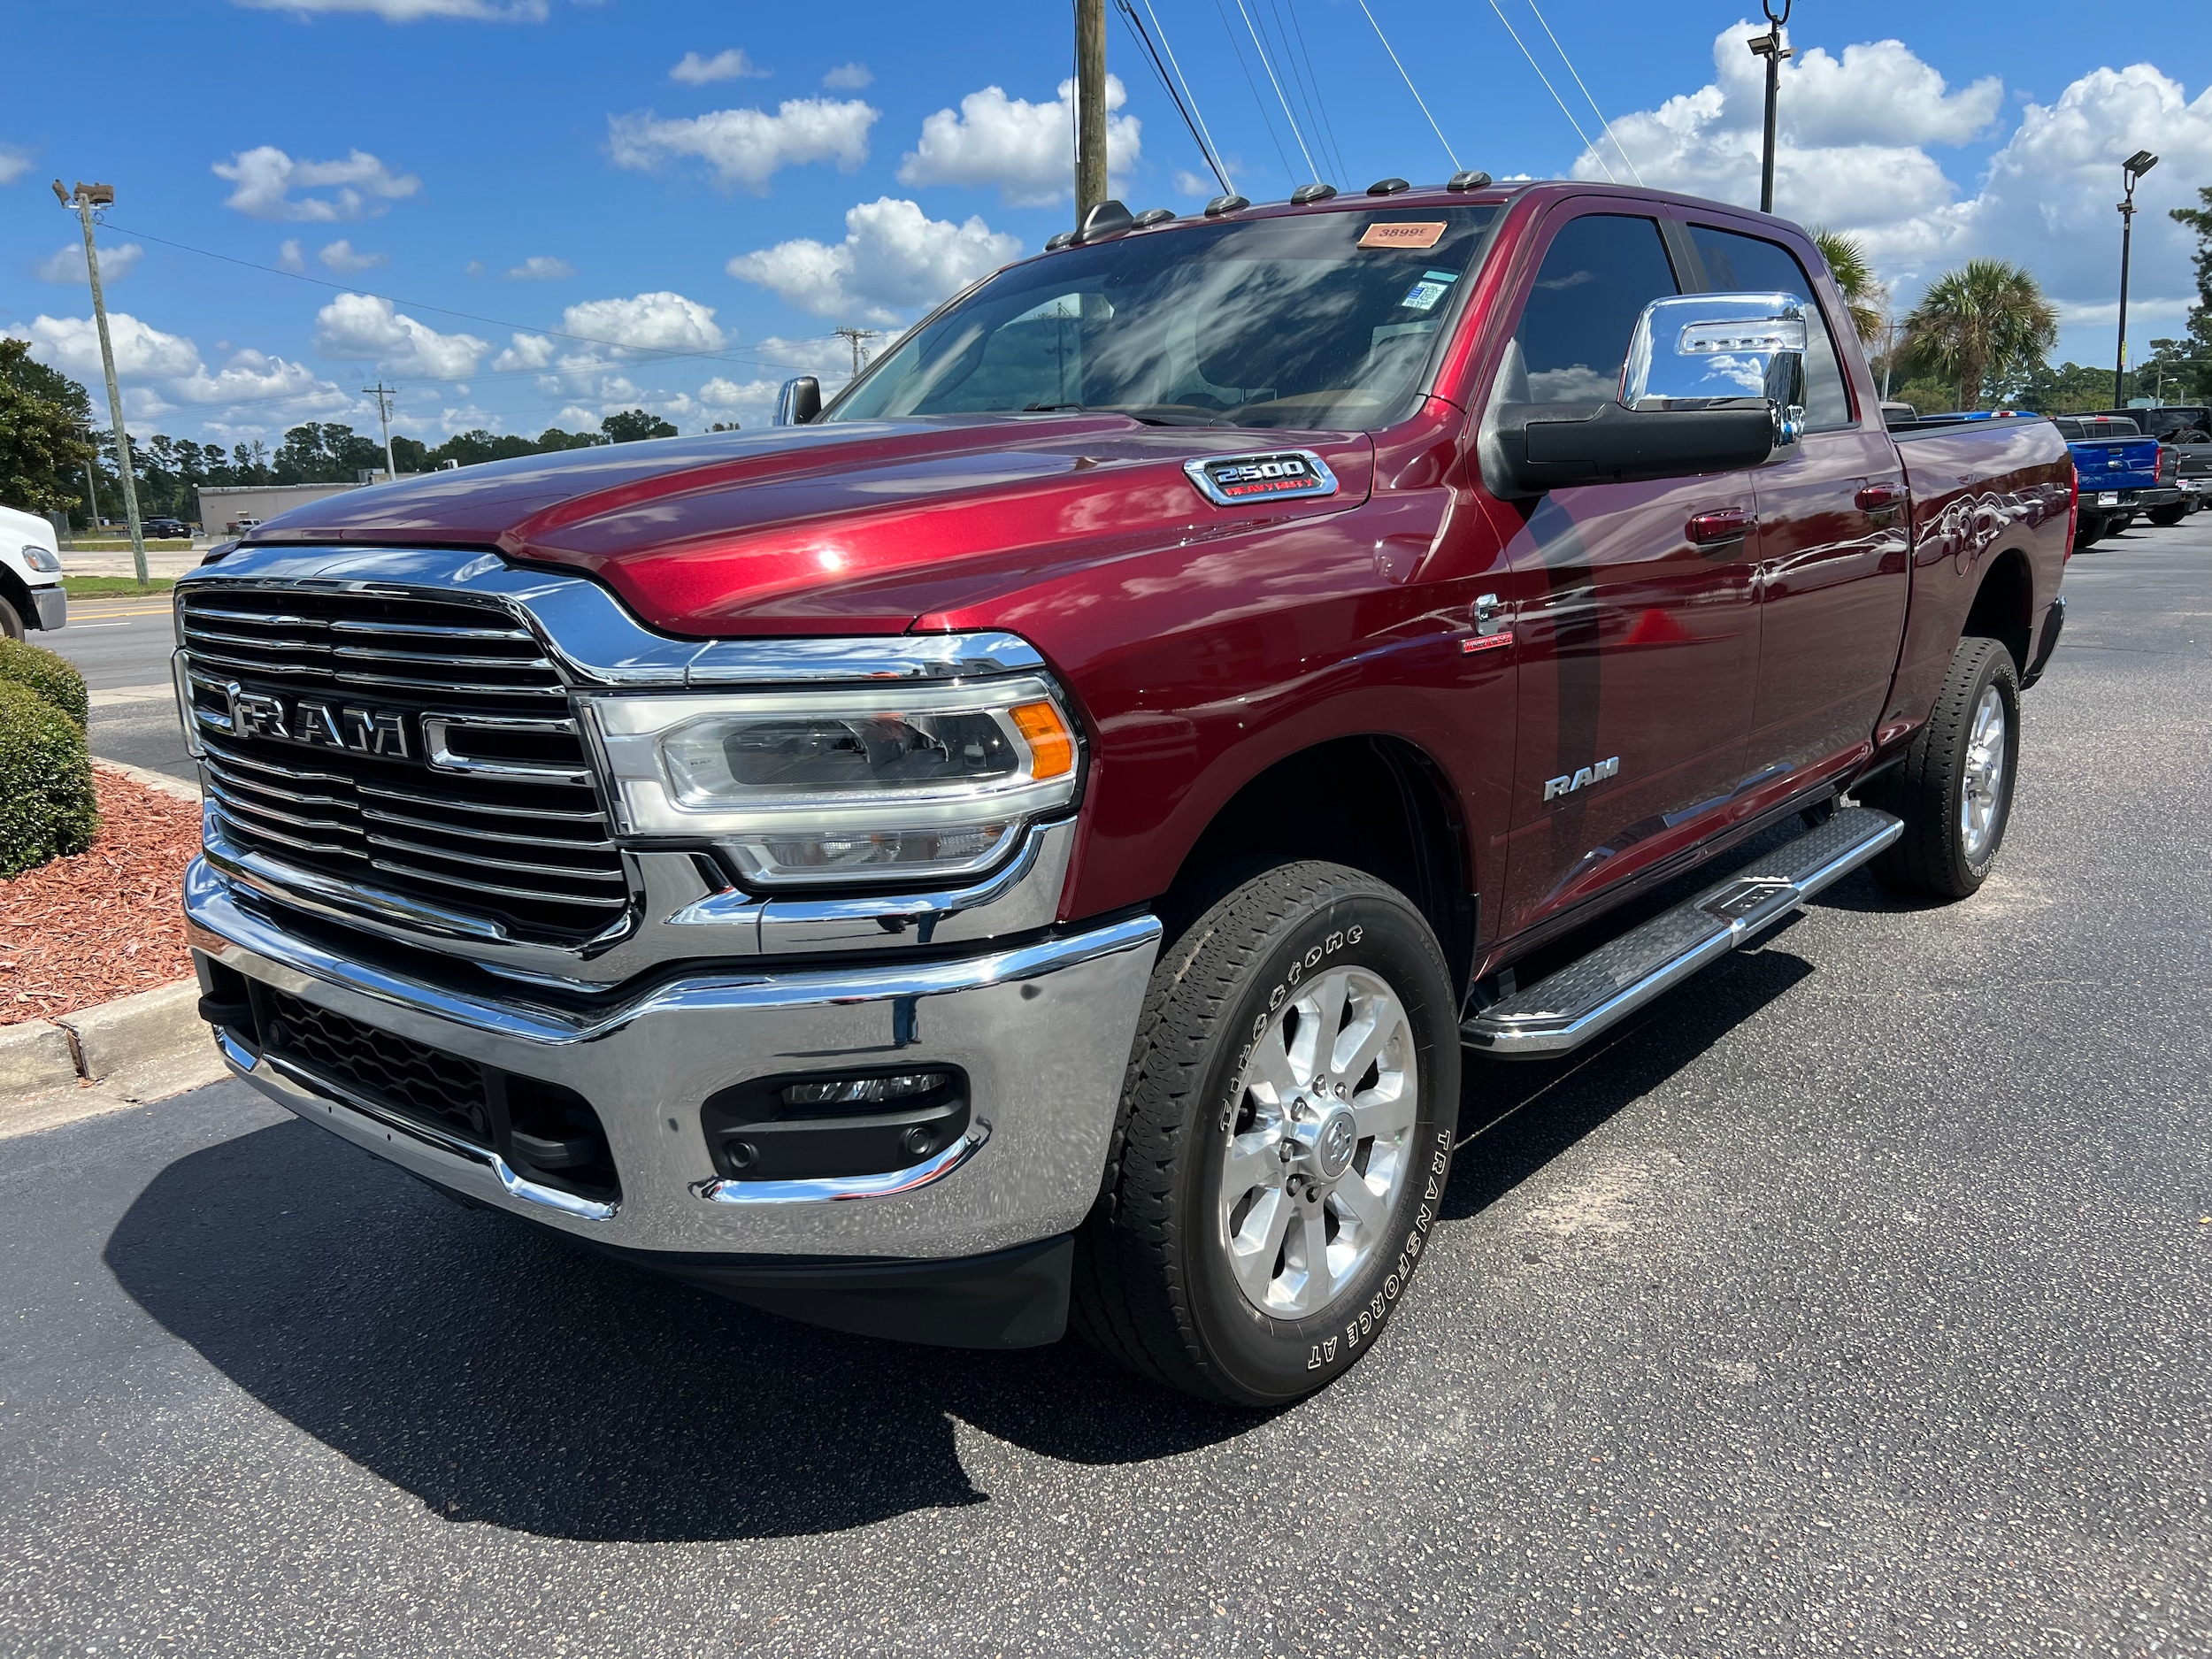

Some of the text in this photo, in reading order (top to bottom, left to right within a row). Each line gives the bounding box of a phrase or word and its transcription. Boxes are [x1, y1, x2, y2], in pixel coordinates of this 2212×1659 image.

[1214, 461, 1305, 484] 2500
[1225, 479, 1312, 495] HEAVY DUTY
[234, 693, 409, 758] RAM
[1544, 757, 1619, 802] RAM
[1347, 1130, 1450, 1348] TRANSFORCE
[1307, 1335, 1338, 1370] AT
